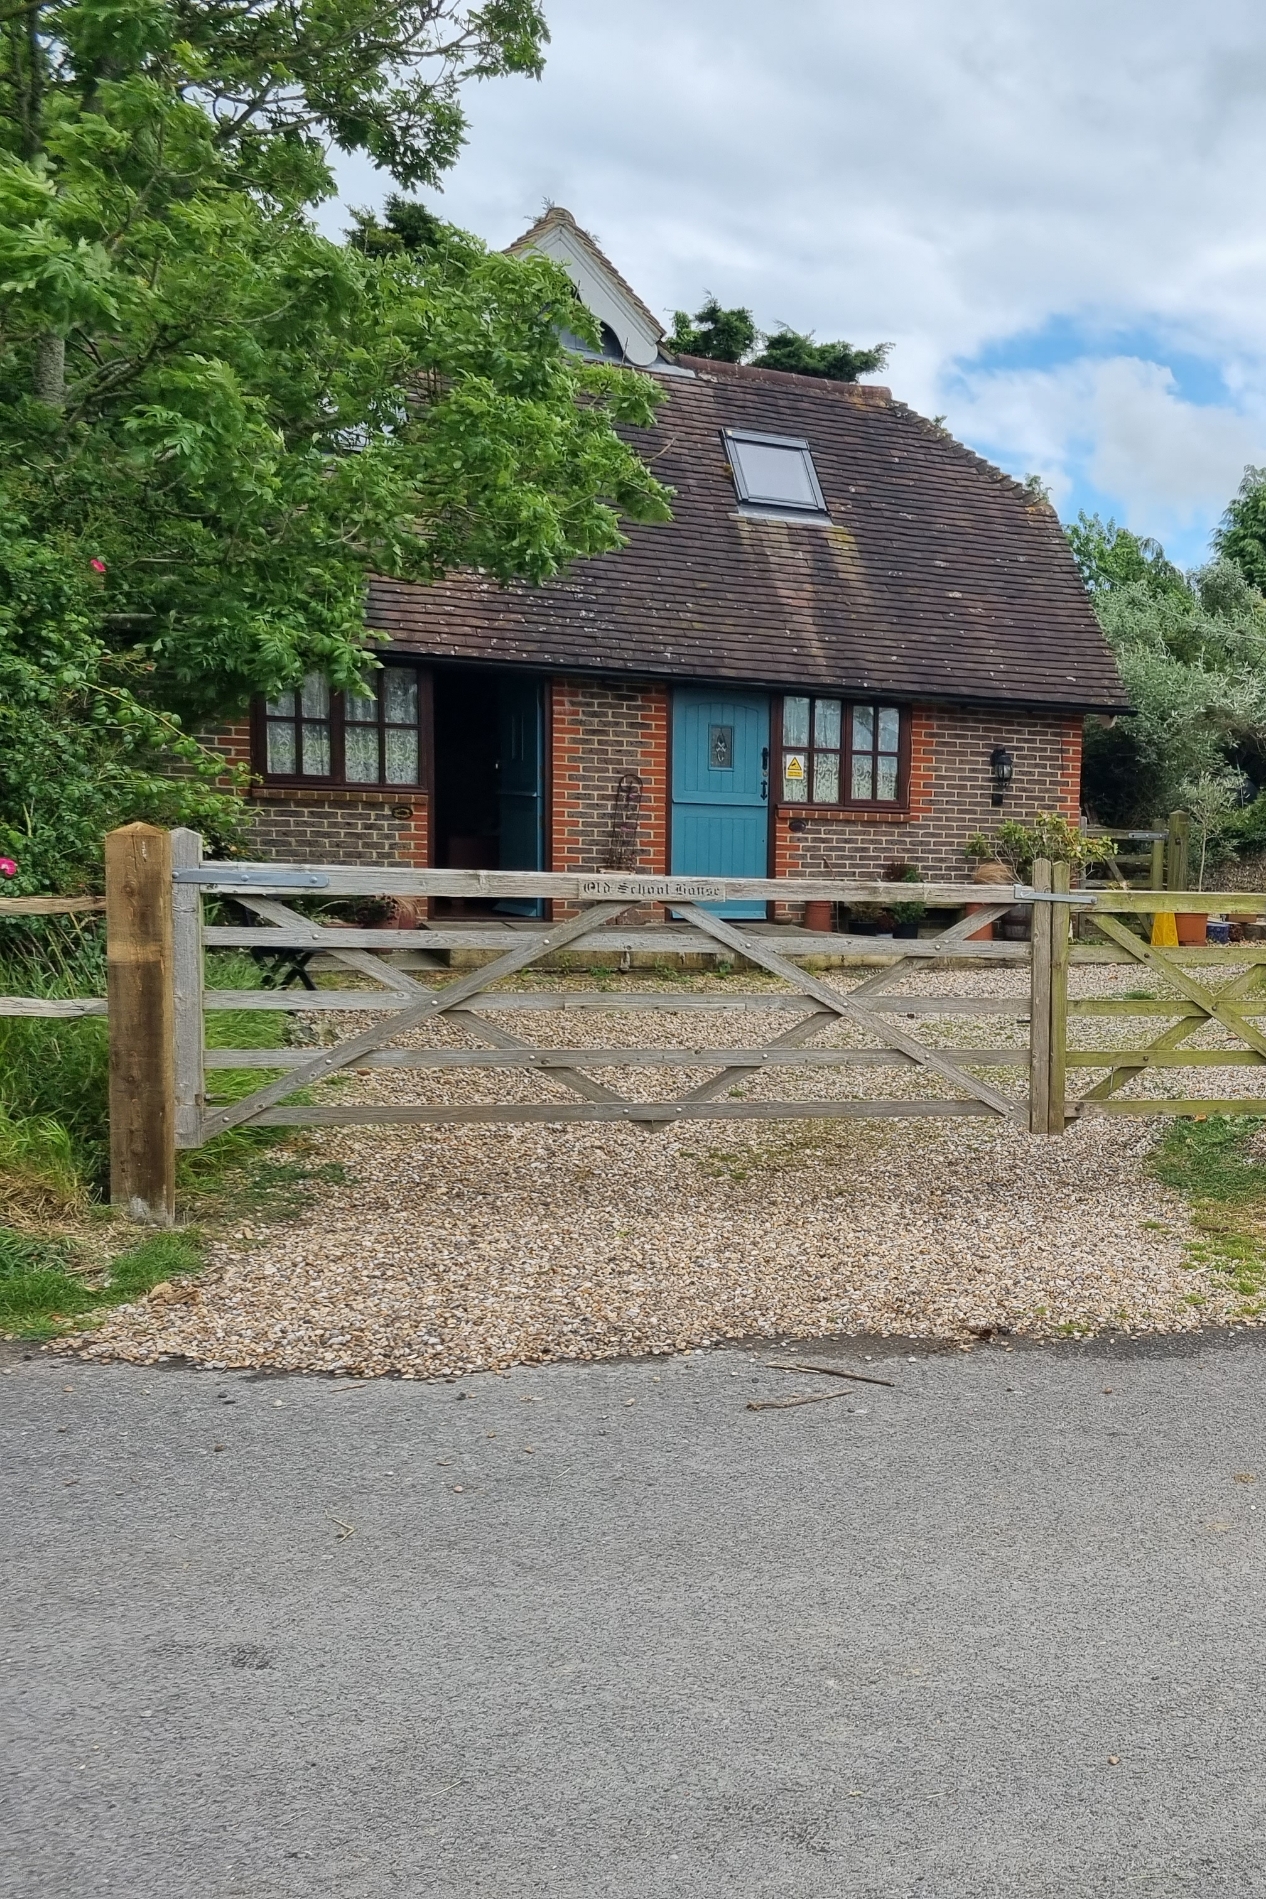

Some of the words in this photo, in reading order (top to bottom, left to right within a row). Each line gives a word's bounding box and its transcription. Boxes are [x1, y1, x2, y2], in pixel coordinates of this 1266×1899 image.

[583, 881, 611, 894] Old
[617, 882, 669, 897] School
[675, 883, 721, 896] House
